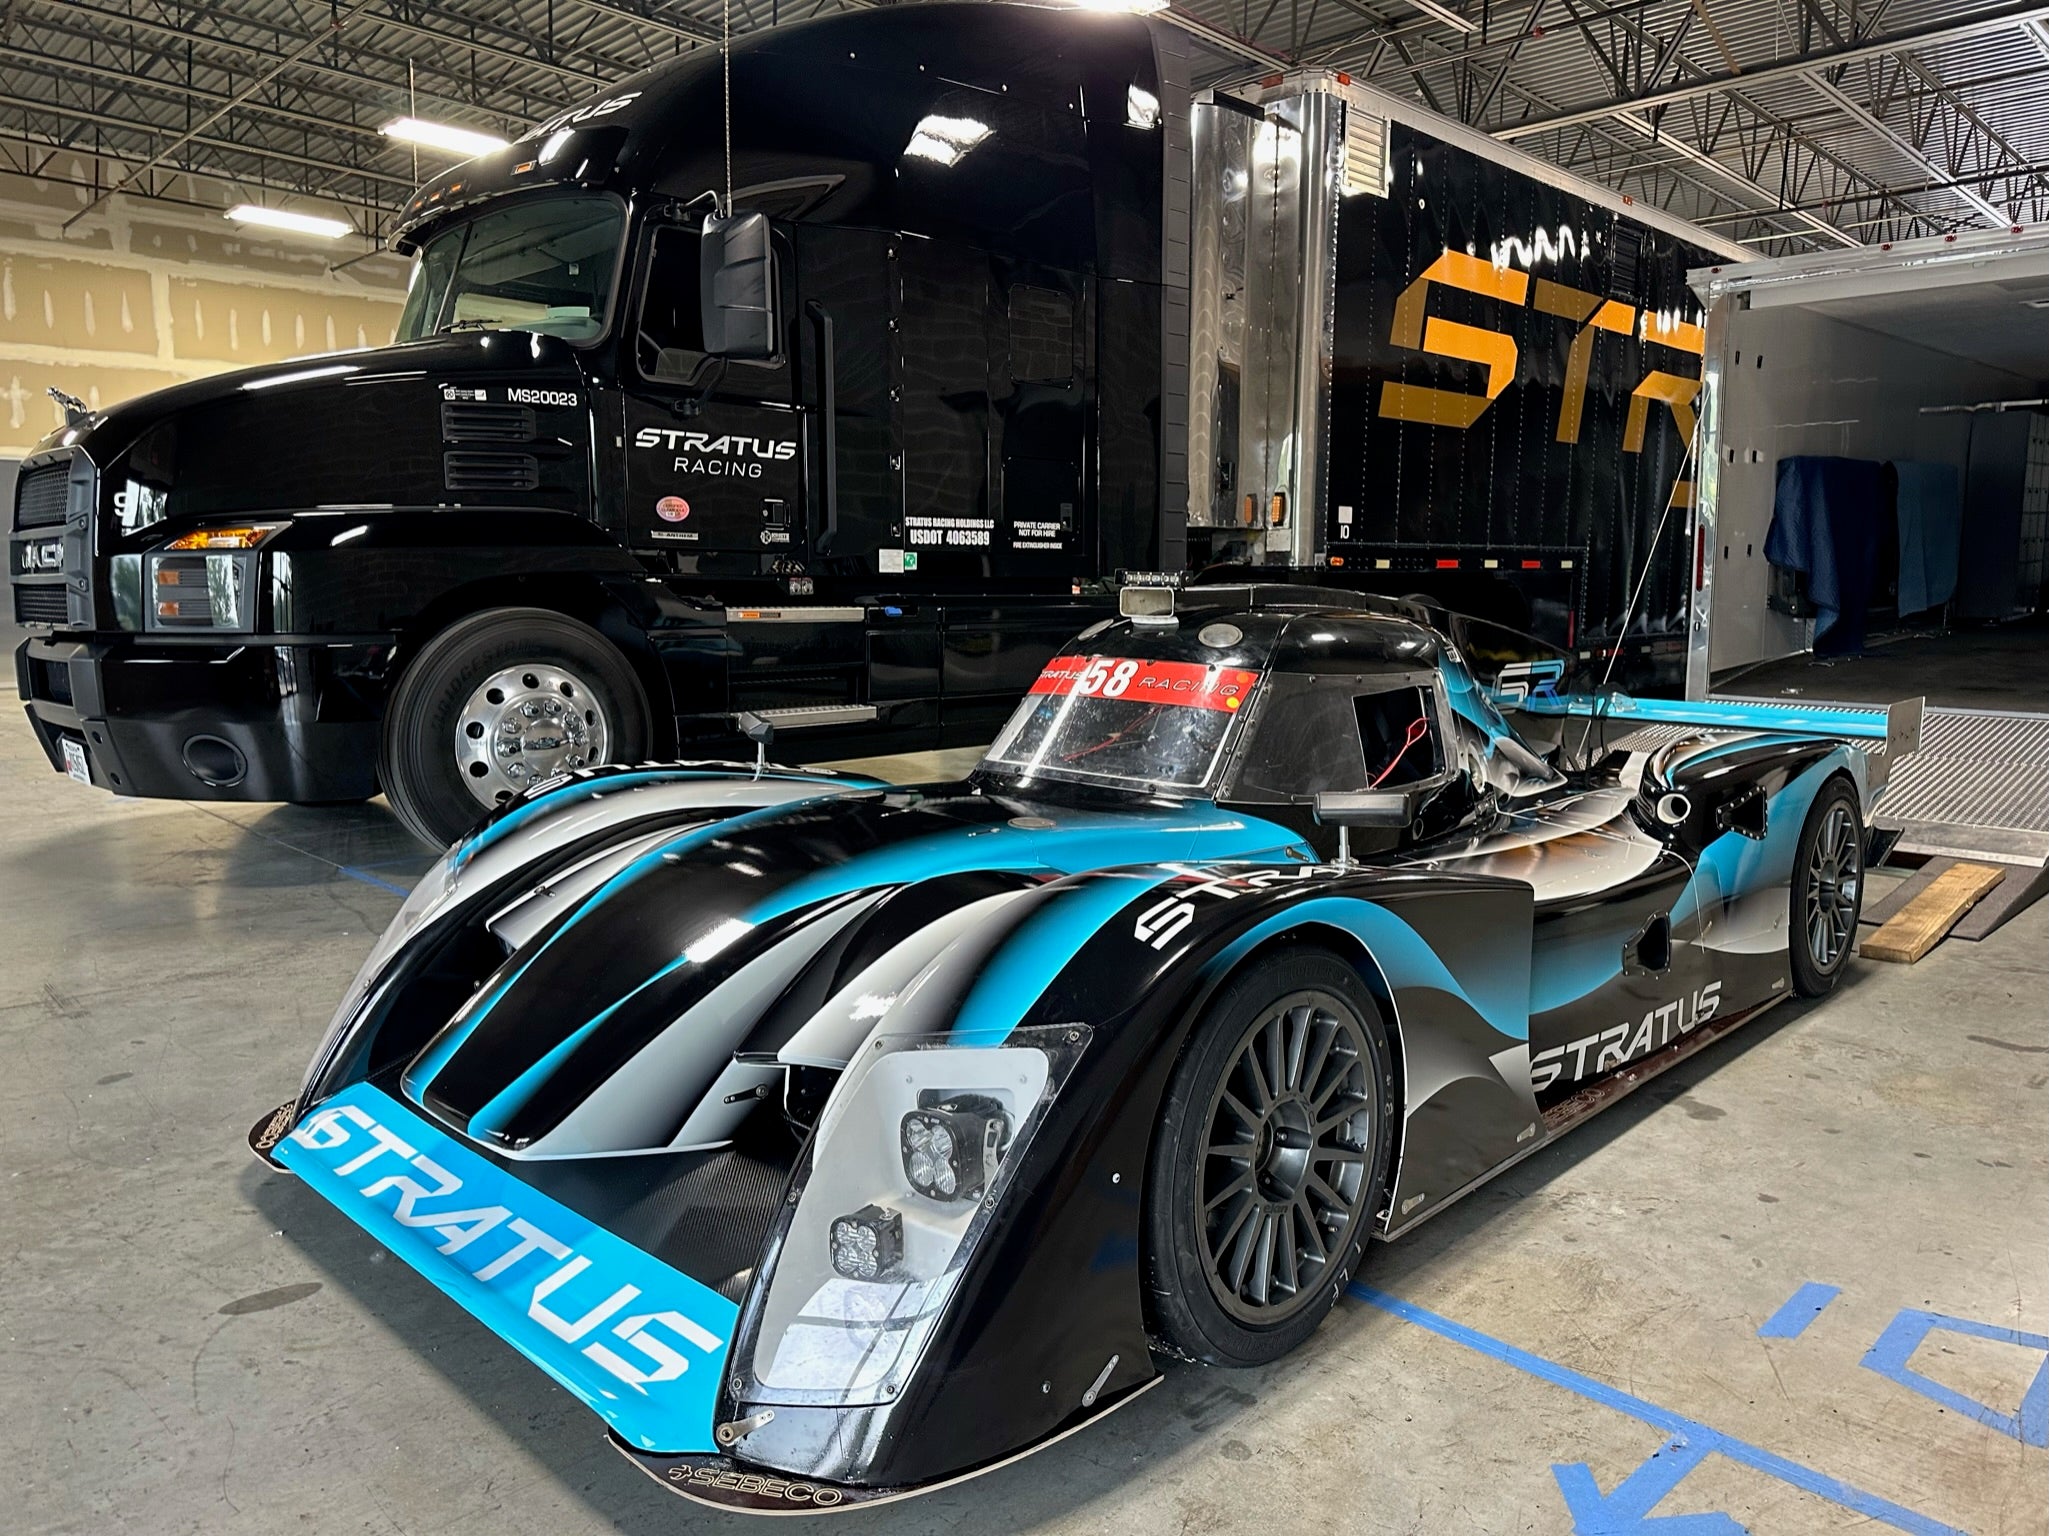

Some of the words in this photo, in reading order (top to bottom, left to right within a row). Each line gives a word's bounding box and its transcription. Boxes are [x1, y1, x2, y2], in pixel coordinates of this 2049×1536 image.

[508, 388, 577, 406] MS20023
[635, 428, 797, 460] STRATUS
[674, 457, 762, 478] RACING
[905, 516, 932, 527] STRATUS
[933, 517, 955, 527] RACING
[985, 519, 994, 529] LLC
[1014, 520, 1036, 529] PRIVATE
[1037, 521, 1060, 530] CARRIER
[1031, 529, 1042, 537] FOR
[910, 529, 943, 544] USDOT
[946, 530, 990, 545] 4063589
[1080, 659, 1139, 697] 58
[1138, 676, 1240, 697] RACING
[1530, 980, 1722, 1093] STRATUS
[288, 1104, 724, 1396] STRATUS
[688, 1467, 842, 1507] SEBECO
